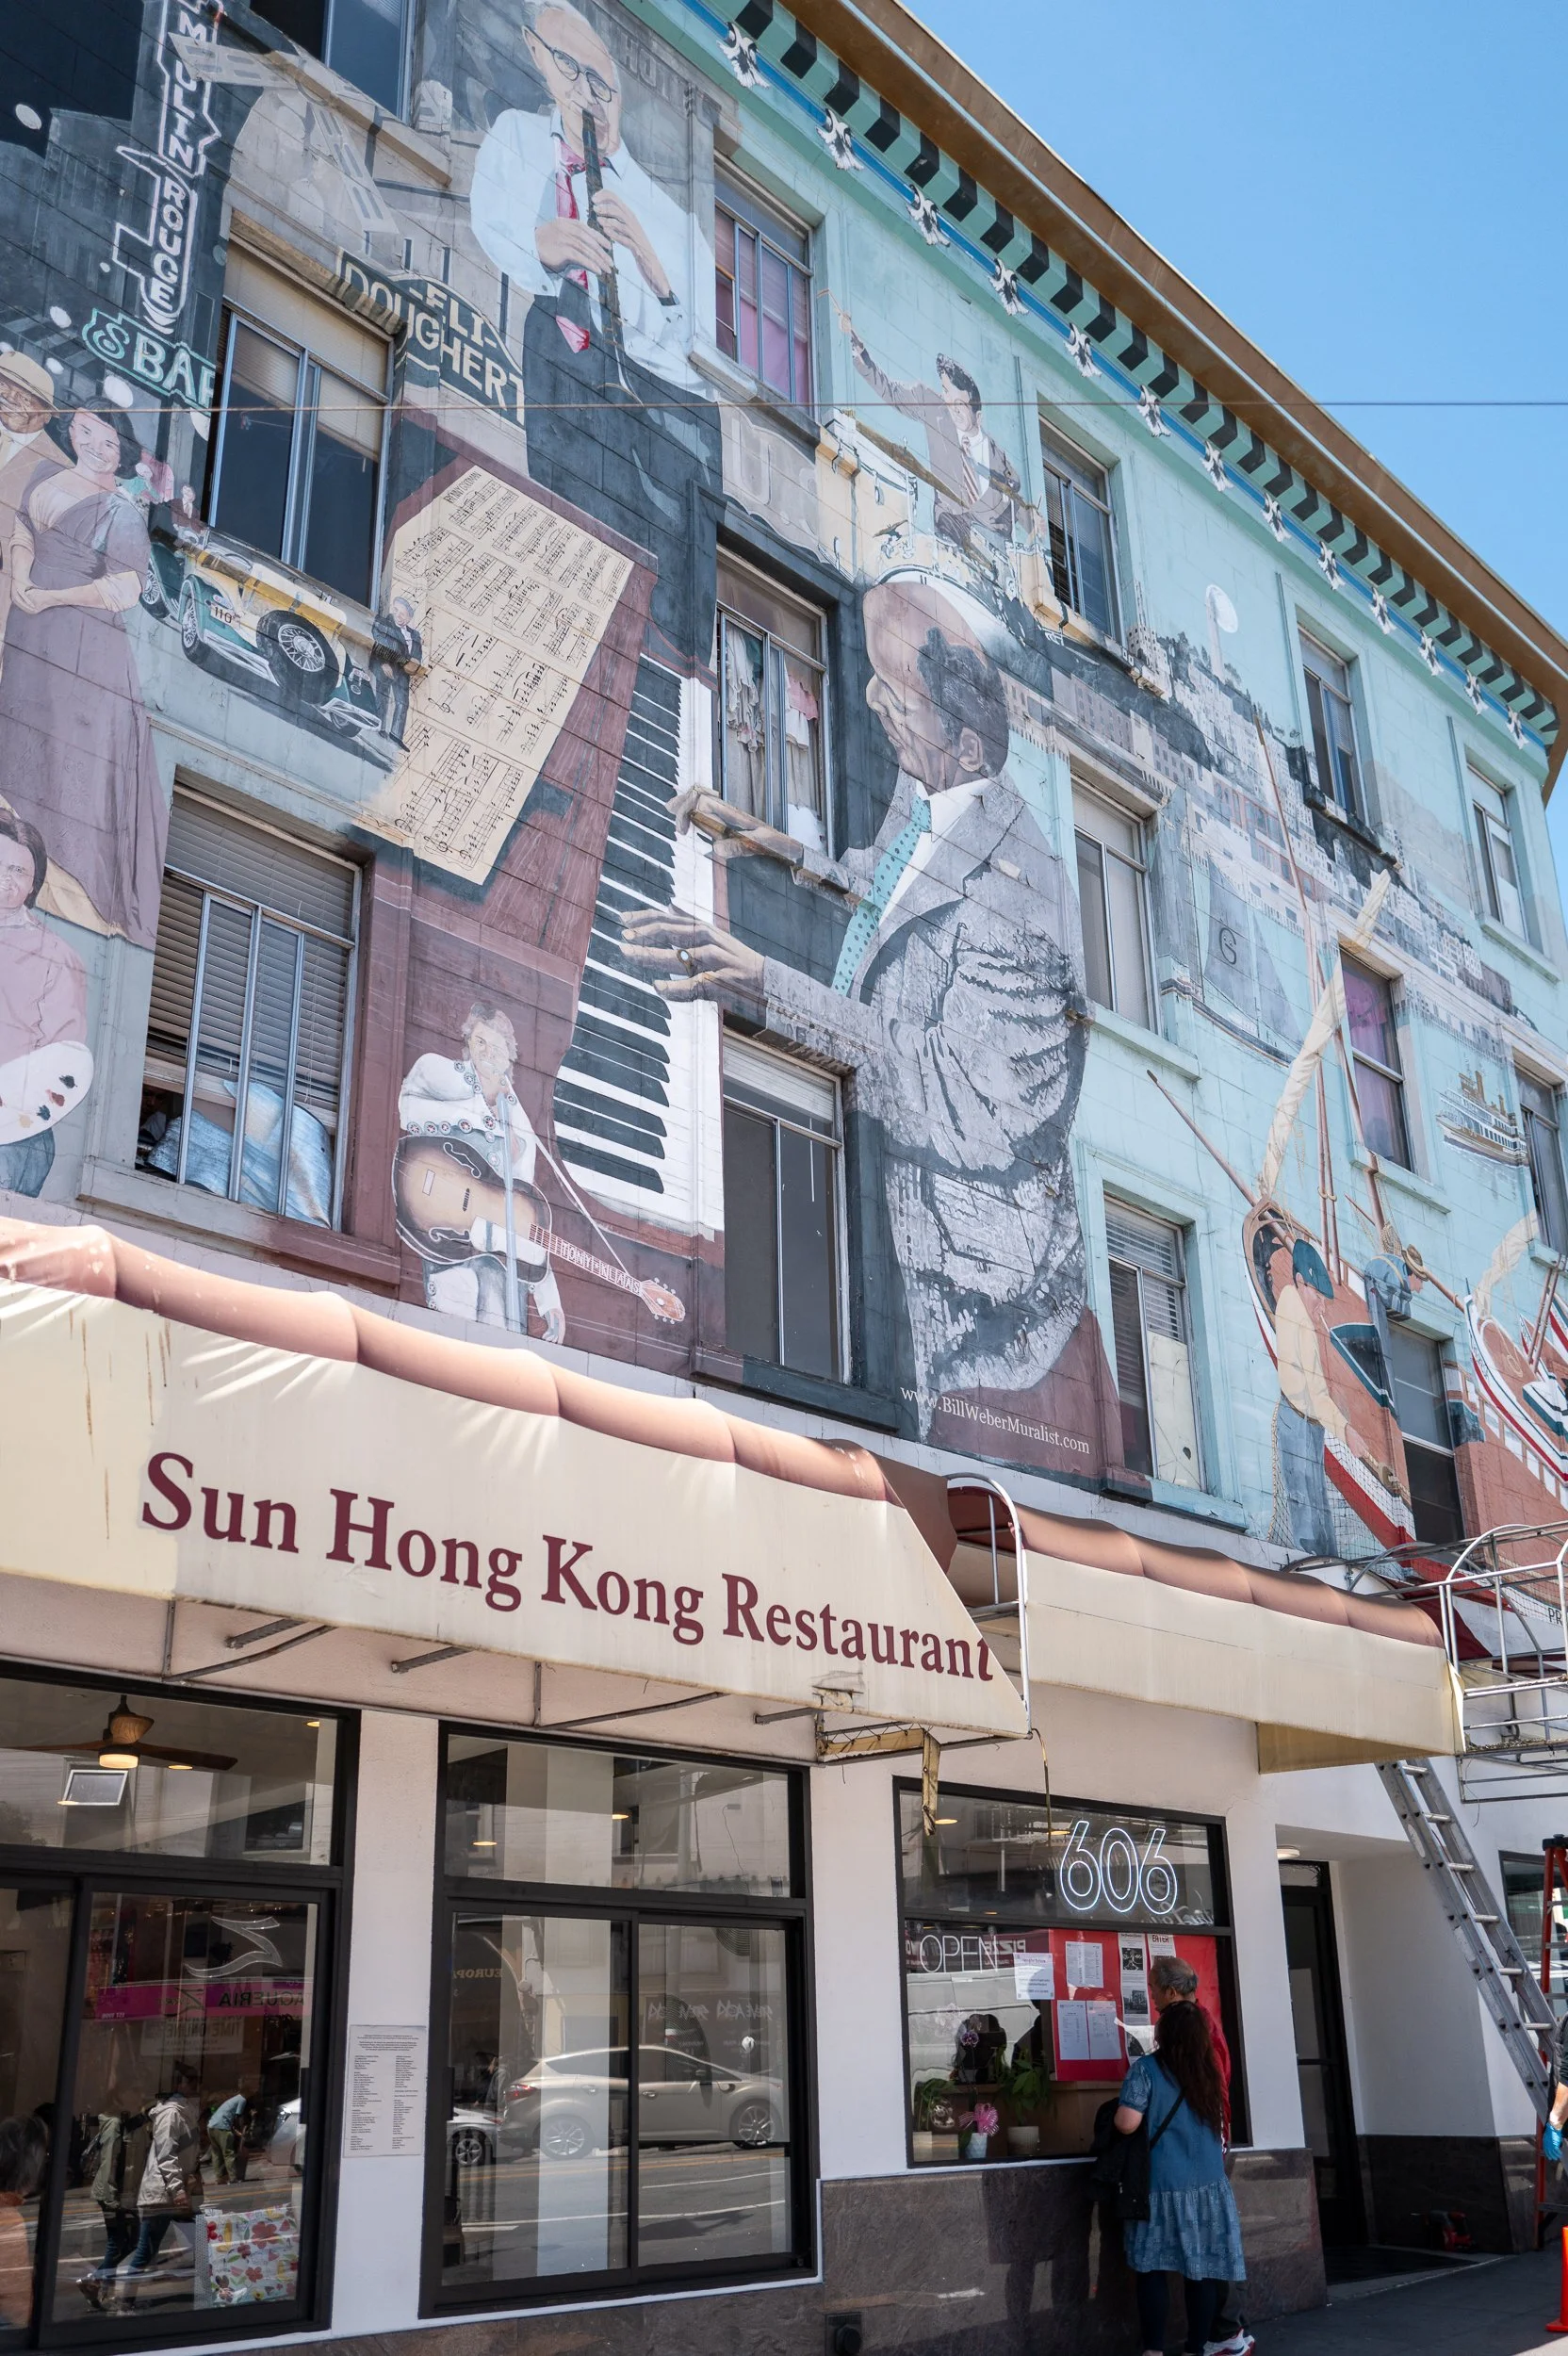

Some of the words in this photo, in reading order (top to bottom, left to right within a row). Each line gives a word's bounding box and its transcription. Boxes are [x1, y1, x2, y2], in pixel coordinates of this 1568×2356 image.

[168, 10, 207, 169] MULIN
[150, 175, 188, 312] ROUGE
[900, 1386, 1090, 1455] www.BillWeberMuralist.com
[141, 1451, 300, 1554] Sun
[326, 1488, 523, 1612] Hong
[541, 1534, 704, 1645] Kong
[721, 1573, 994, 1682] Restaurant
[1059, 1820, 1179, 1915] 606
[920, 1935, 998, 1974] OPEN
